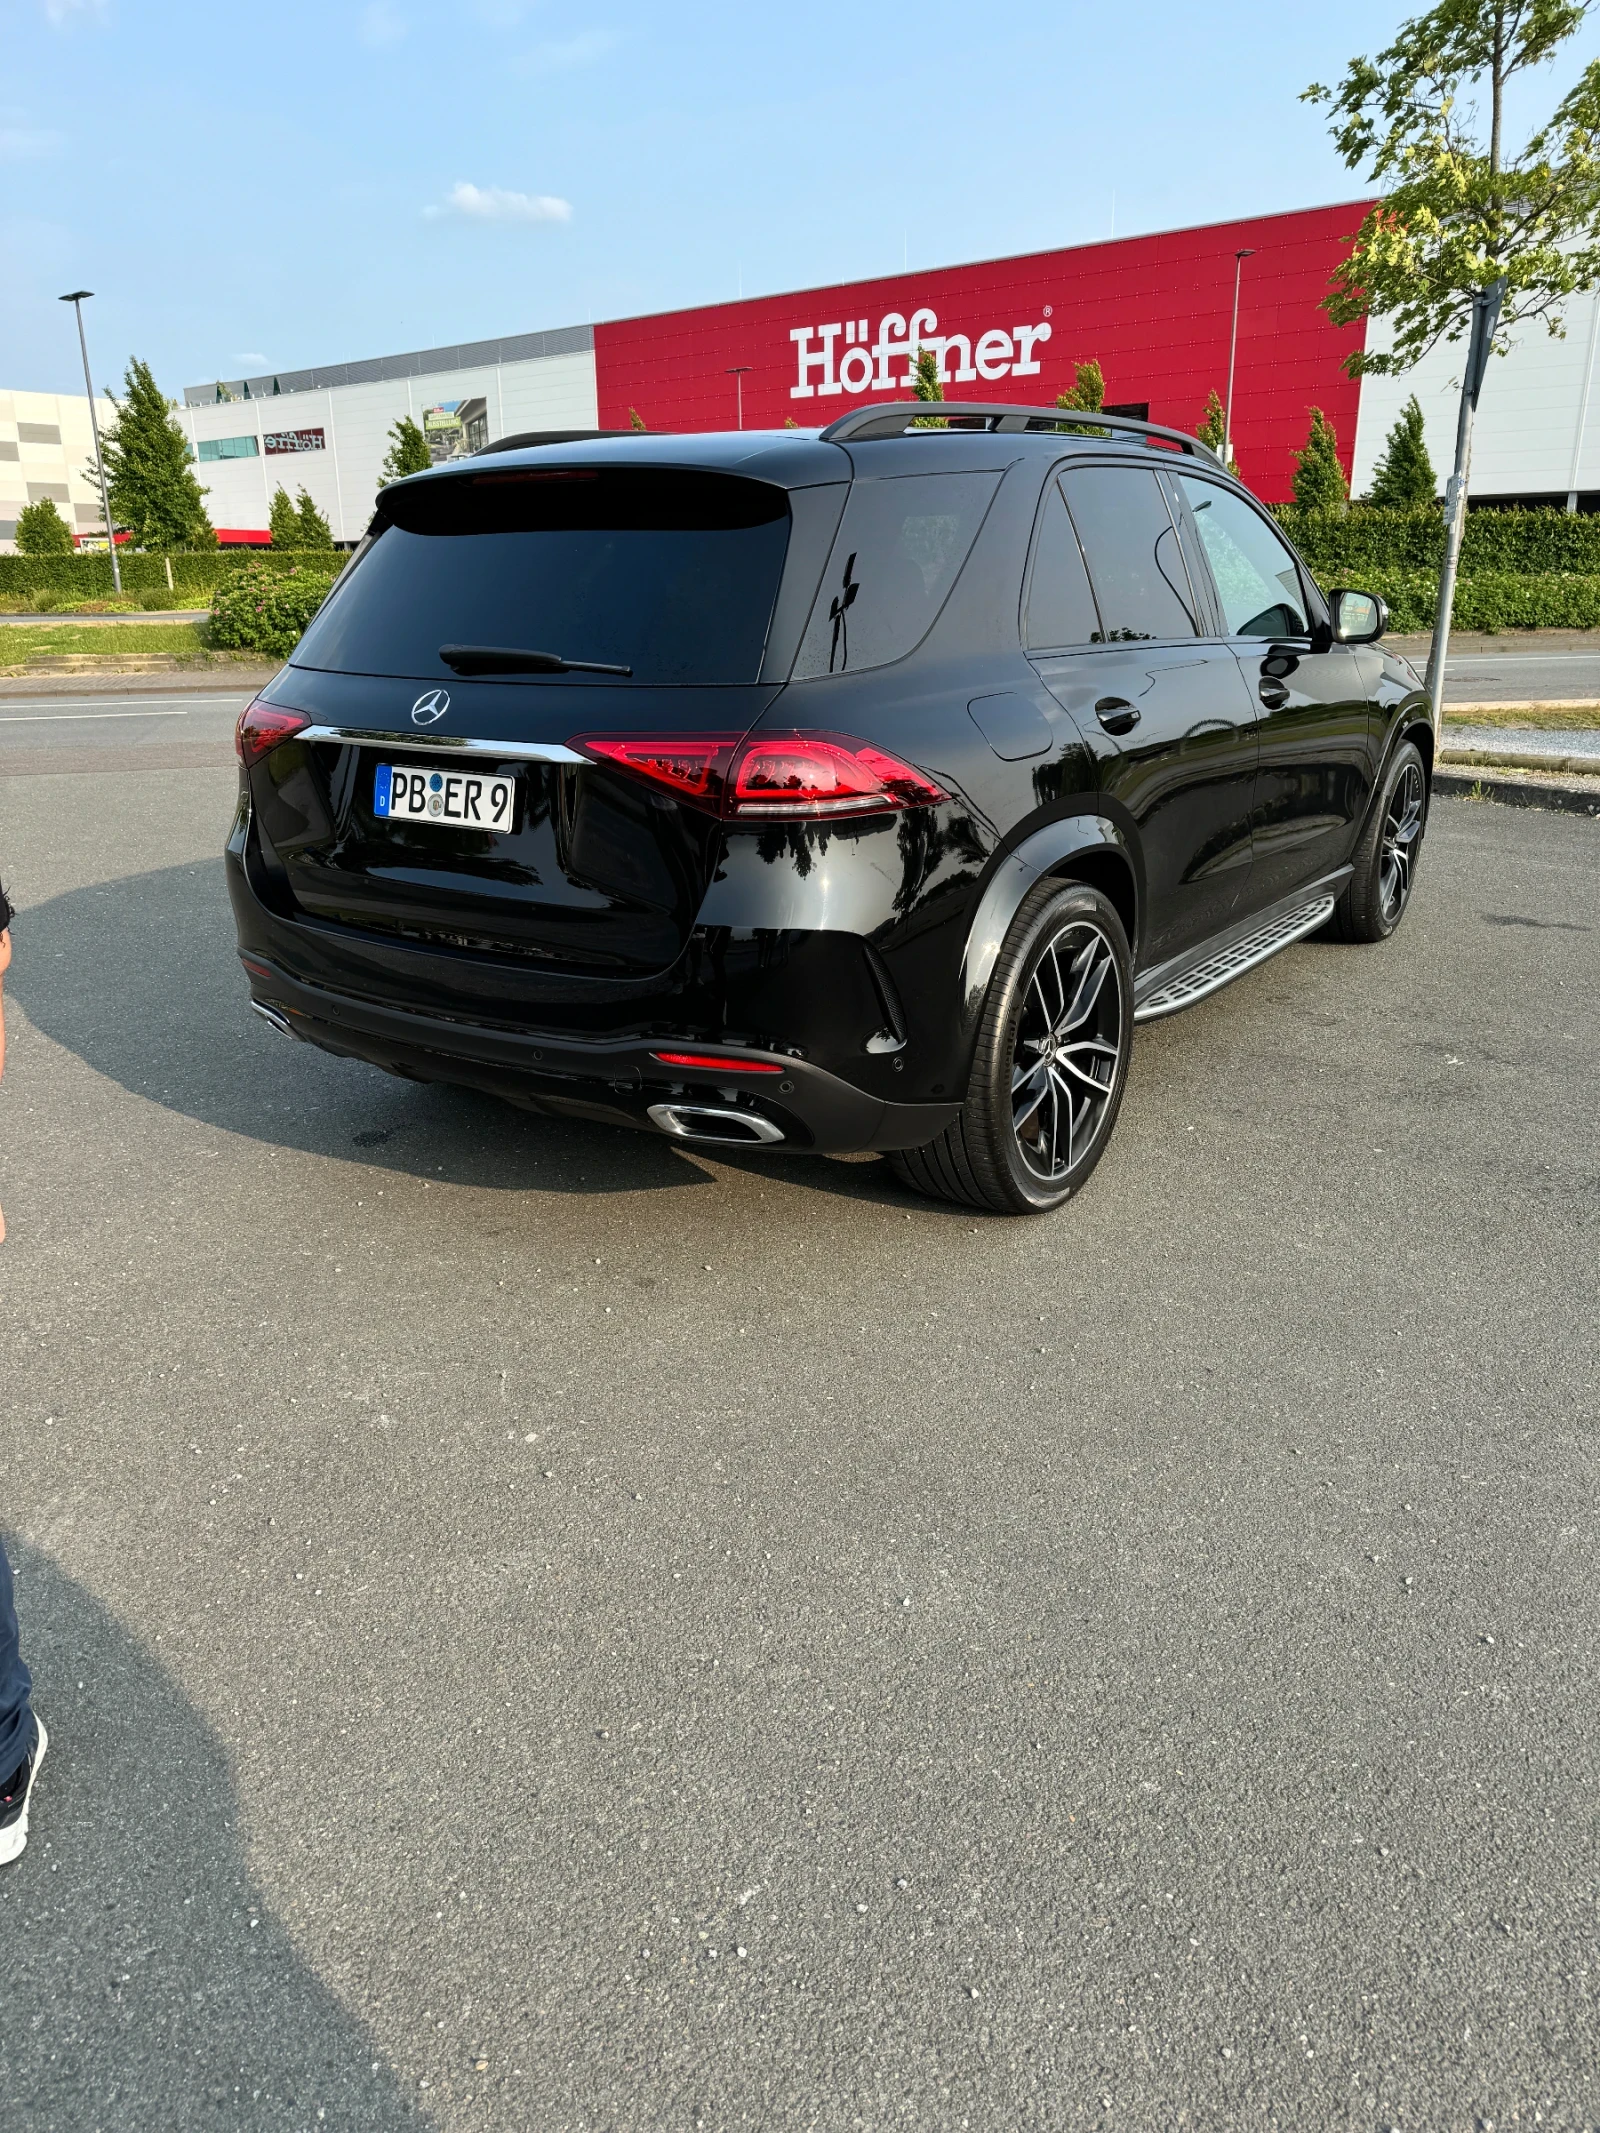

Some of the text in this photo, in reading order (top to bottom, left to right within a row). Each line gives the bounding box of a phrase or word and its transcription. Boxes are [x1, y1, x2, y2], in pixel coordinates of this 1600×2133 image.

[789, 308, 1052, 399] Höffner
[379, 795, 386, 807] D
[391, 772, 509, 823] PB ER 9
